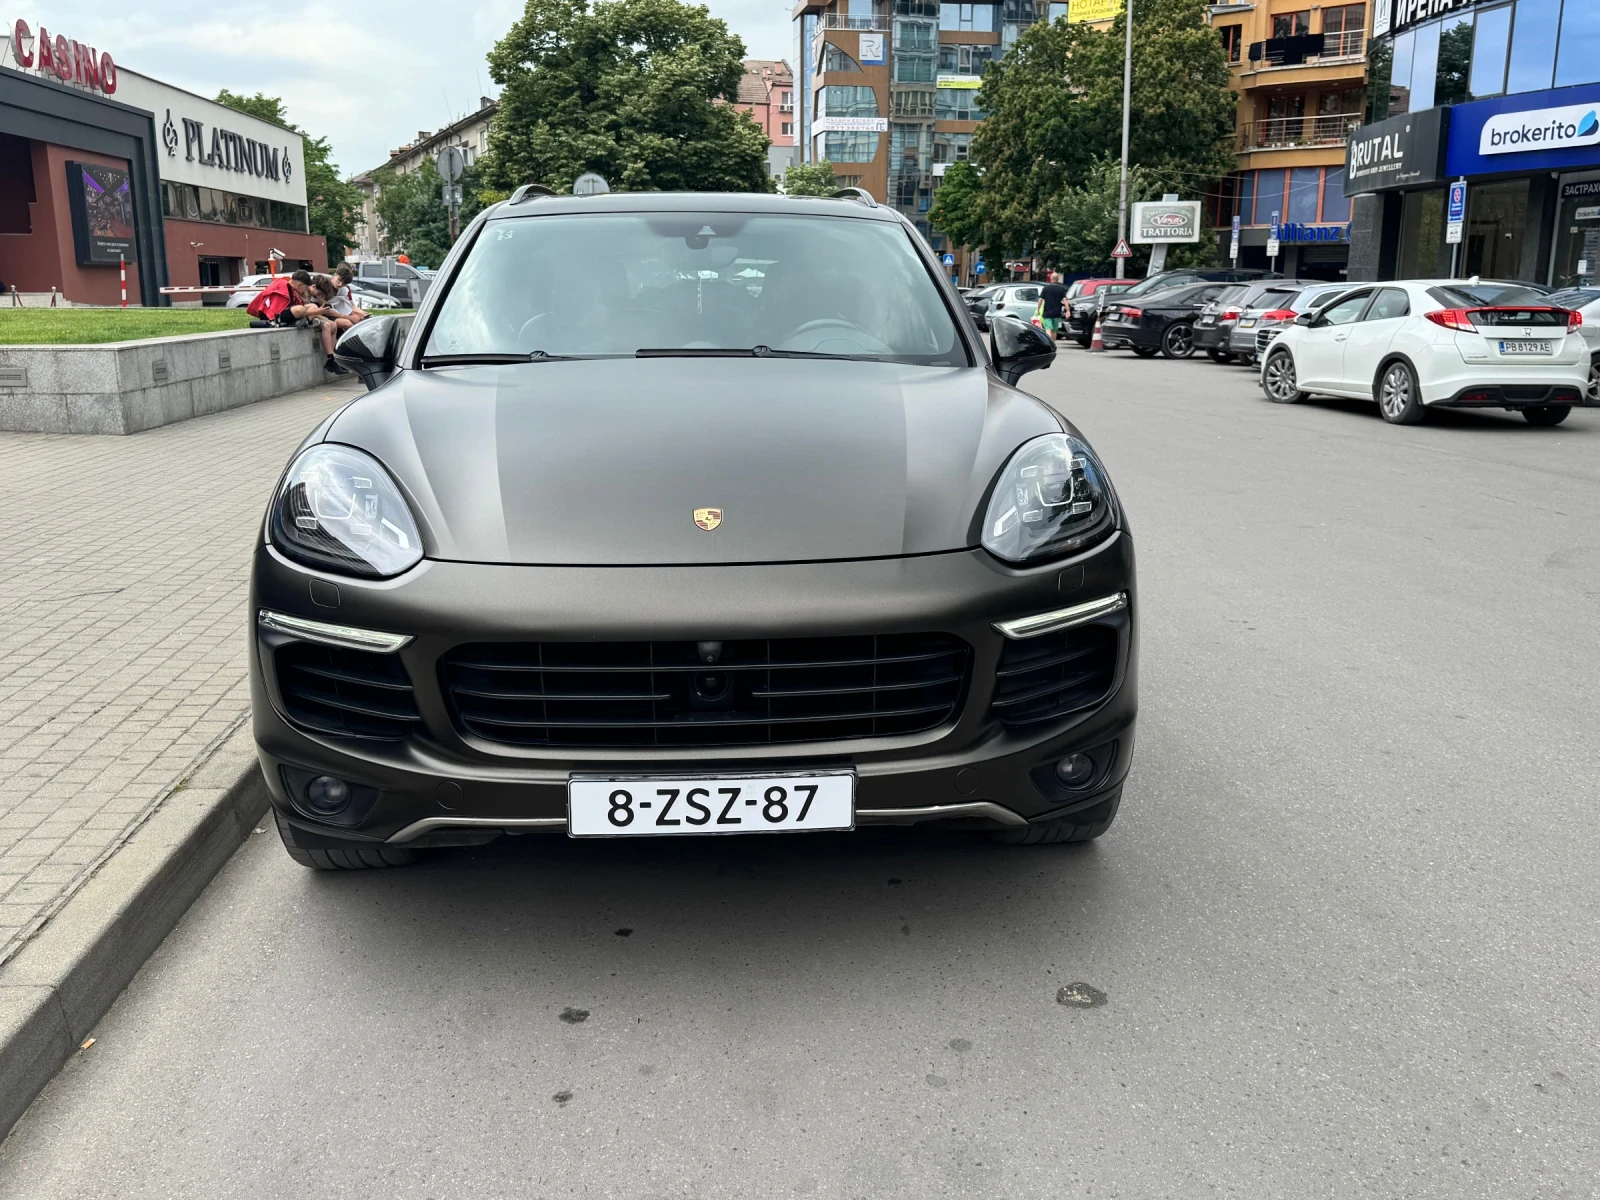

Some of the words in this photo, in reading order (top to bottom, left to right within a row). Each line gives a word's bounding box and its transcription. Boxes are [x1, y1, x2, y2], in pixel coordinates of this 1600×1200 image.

[14, 18, 116, 94] CASINO
[182, 117, 280, 182] PLATINUM
[1491, 120, 1576, 146] brokerito
[1349, 133, 1403, 180] BRUTAL
[1142, 227, 1193, 237] TRATTORIA
[1518, 342, 1538, 352] 8129
[1540, 343, 1551, 352] AE
[607, 784, 819, 827] 8-ZSZ-87
